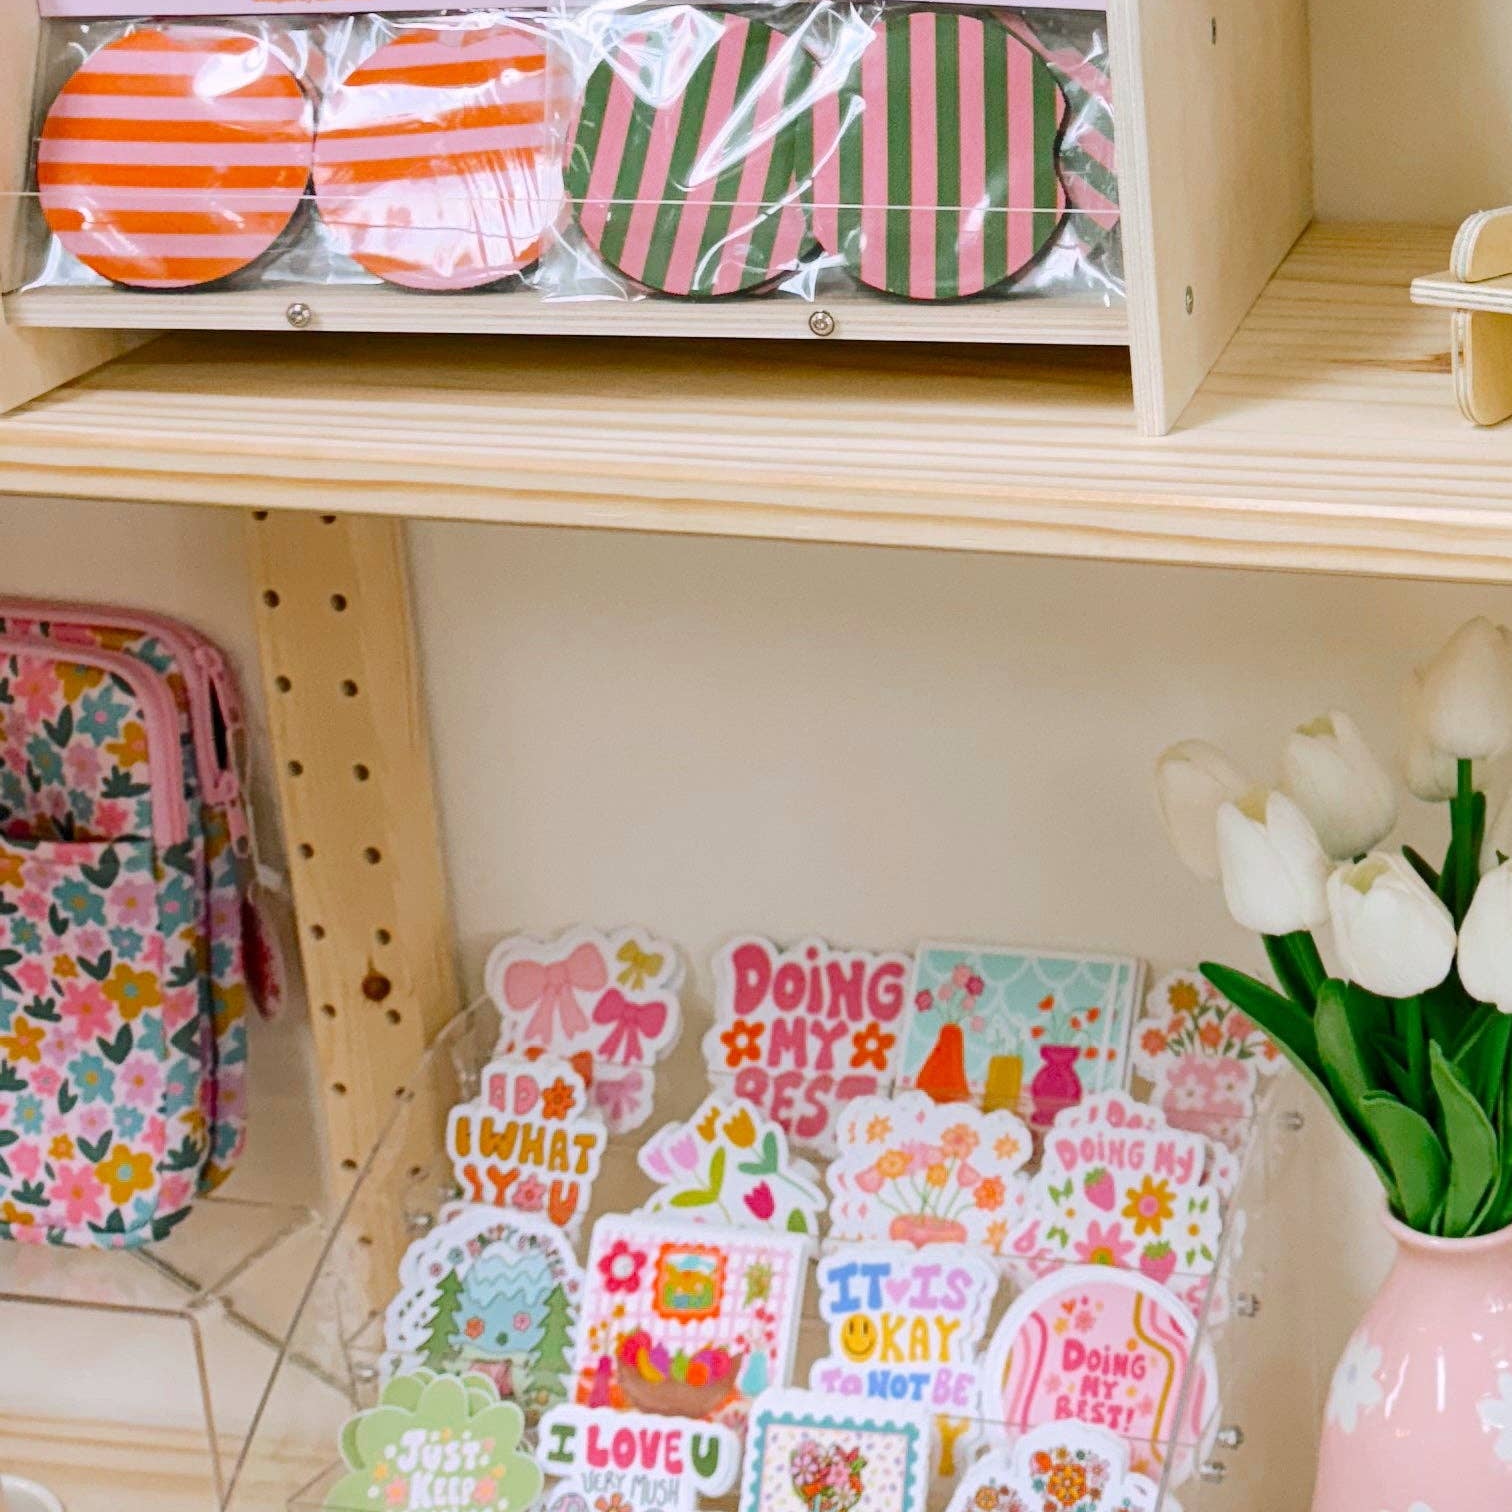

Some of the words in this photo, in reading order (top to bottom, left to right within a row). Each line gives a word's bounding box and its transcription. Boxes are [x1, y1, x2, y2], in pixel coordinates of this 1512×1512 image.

[767, 1016, 848, 1070] MY
[479, 1116, 597, 1174] WHAT
[827, 1263, 891, 1313] IT
[909, 1264, 972, 1311] IS
[867, 1369, 931, 1401] NOT
[931, 1366, 975, 1406] BE
[1081, 1375, 1118, 1399] MY
[1055, 1395, 1135, 1432] BEST!
[548, 1423, 576, 1463] I
[587, 1425, 684, 1475] LOVE
[692, 1433, 719, 1477] U
[581, 1471, 624, 1494] VERY
[631, 1474, 680, 1506] MUSH
